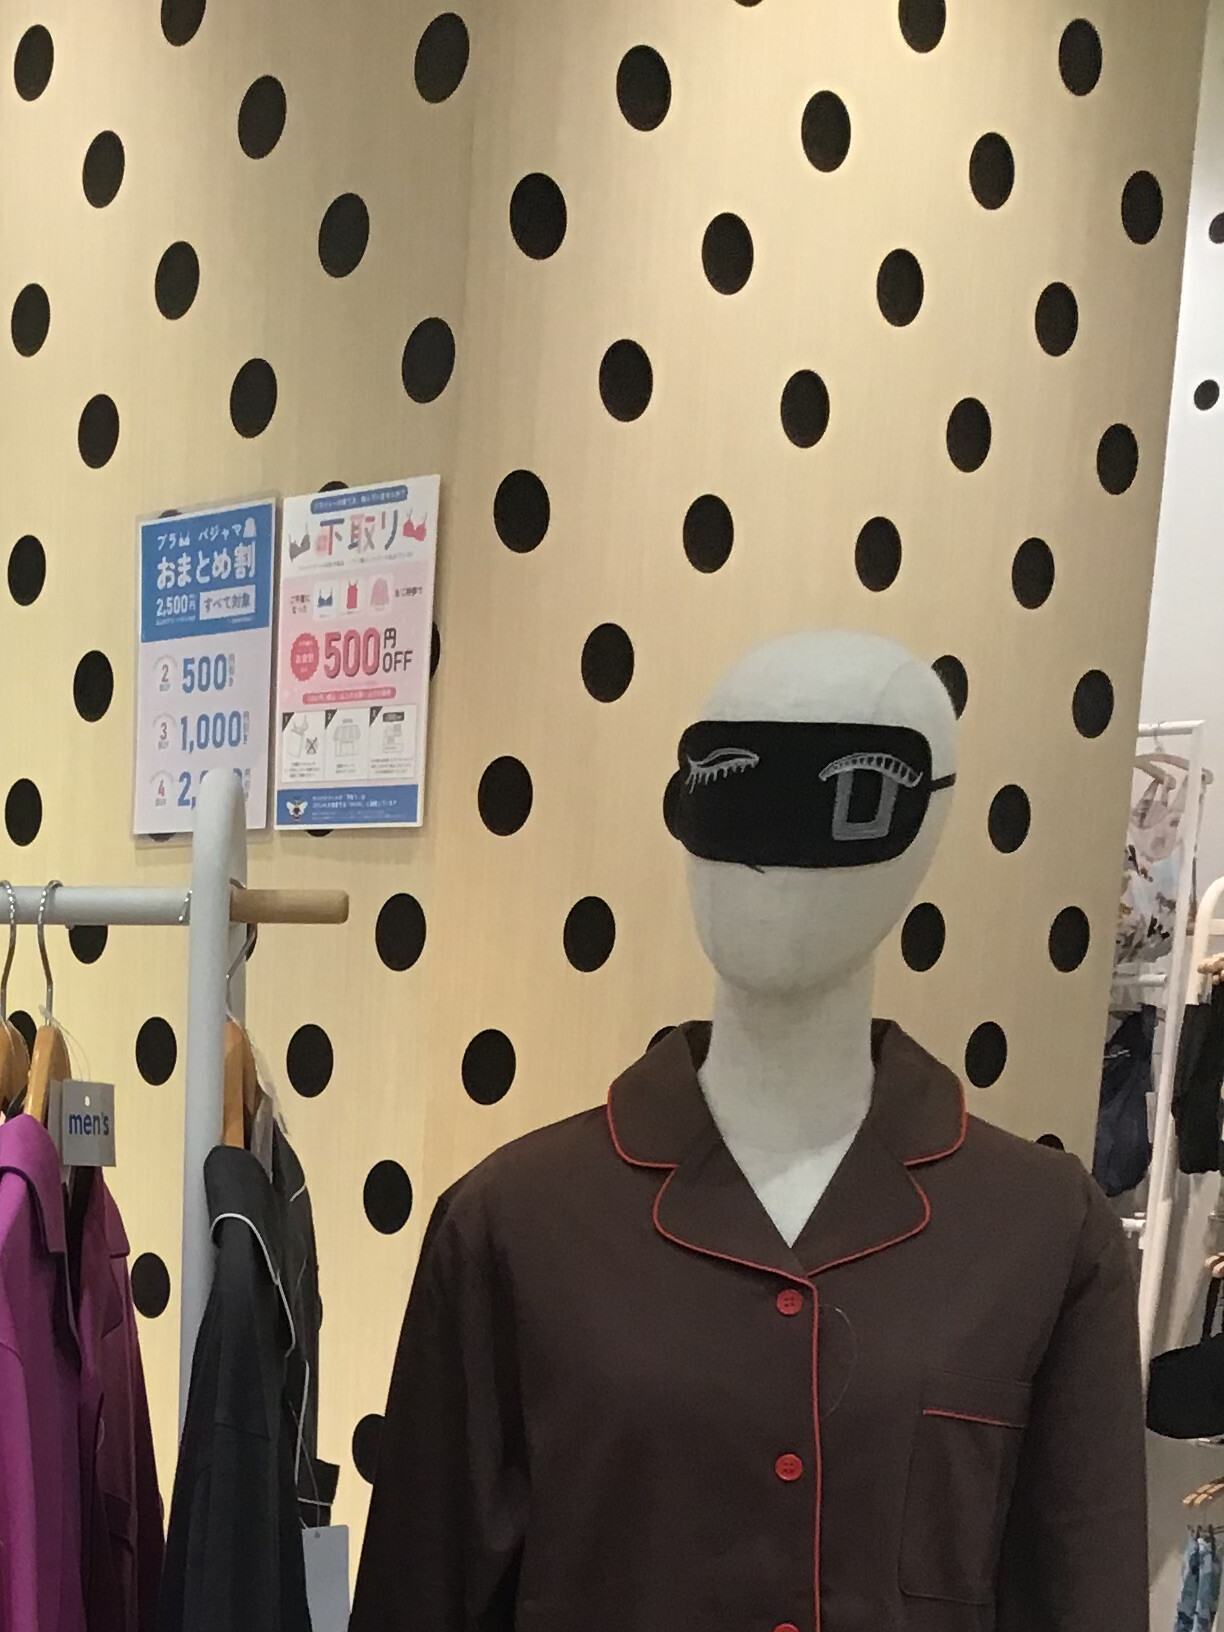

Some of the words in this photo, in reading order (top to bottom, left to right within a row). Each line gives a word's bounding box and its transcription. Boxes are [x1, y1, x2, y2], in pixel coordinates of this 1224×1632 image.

[318, 509, 399, 556] 下取り
[156, 540, 256, 591] おまとめ割
[182, 653, 227, 693] 500
[382, 650, 413, 673] OFF
[180, 710, 242, 754] 1,000
[68, 1113, 110, 1136] men's
